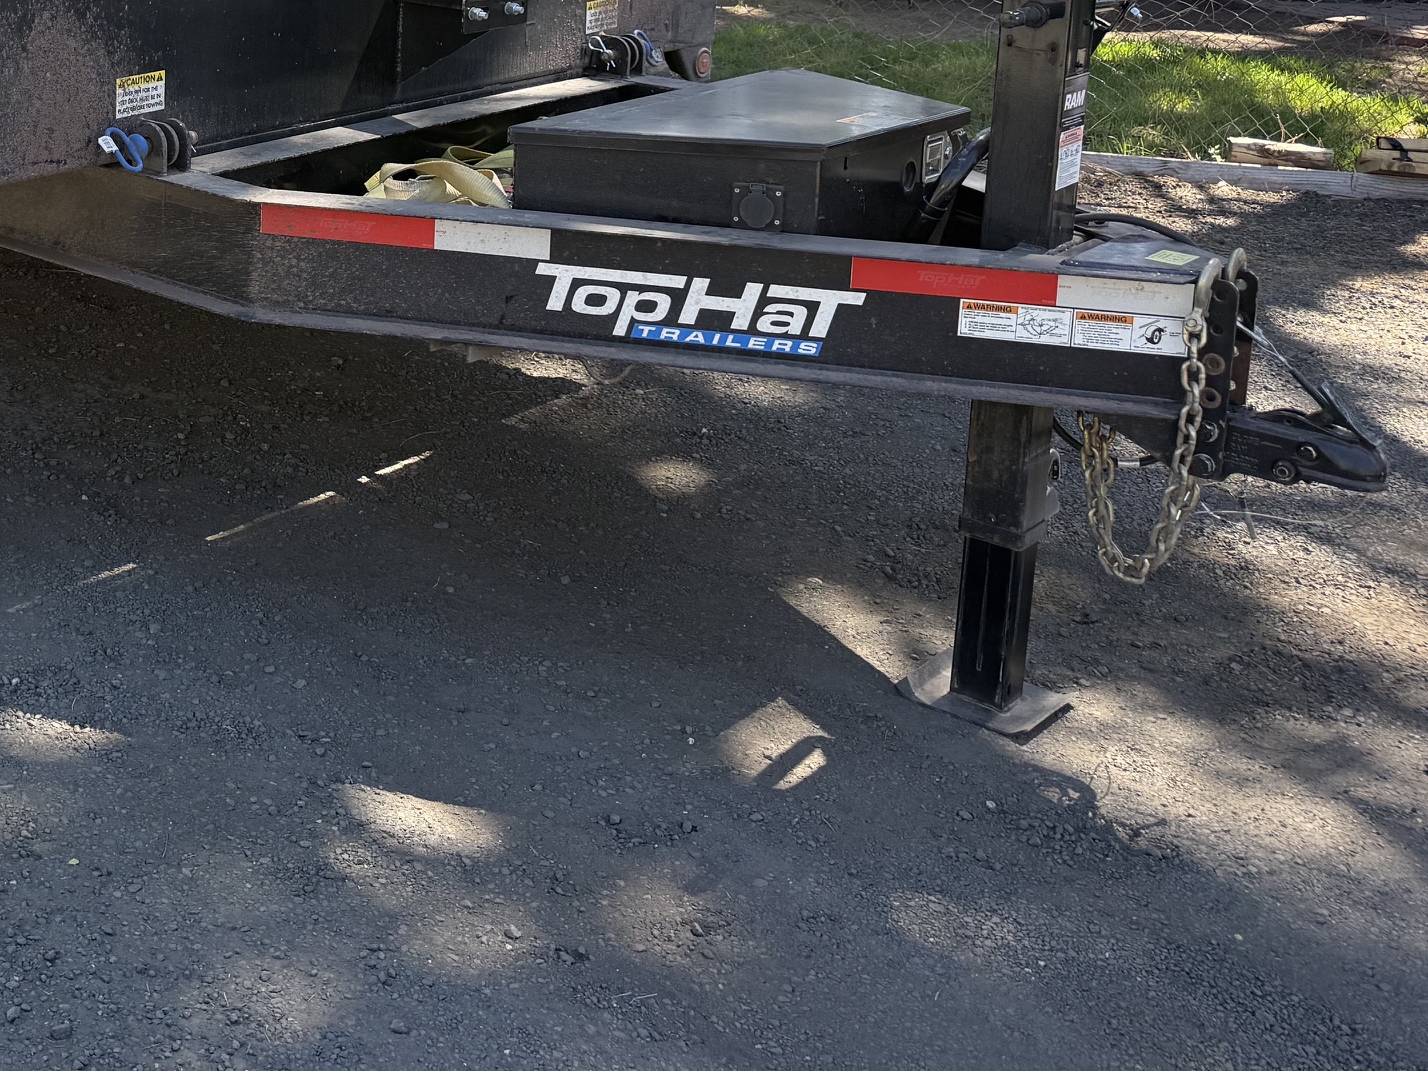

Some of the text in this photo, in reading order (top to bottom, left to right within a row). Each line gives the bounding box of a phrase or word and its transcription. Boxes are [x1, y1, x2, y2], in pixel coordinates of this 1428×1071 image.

[125, 74, 156, 87] CAUTION
[1064, 89, 1086, 110] RAM
[973, 303, 1012, 313] WARNING
[1086, 312, 1127, 323] WARNING
[638, 325, 819, 355] TRAILERS
